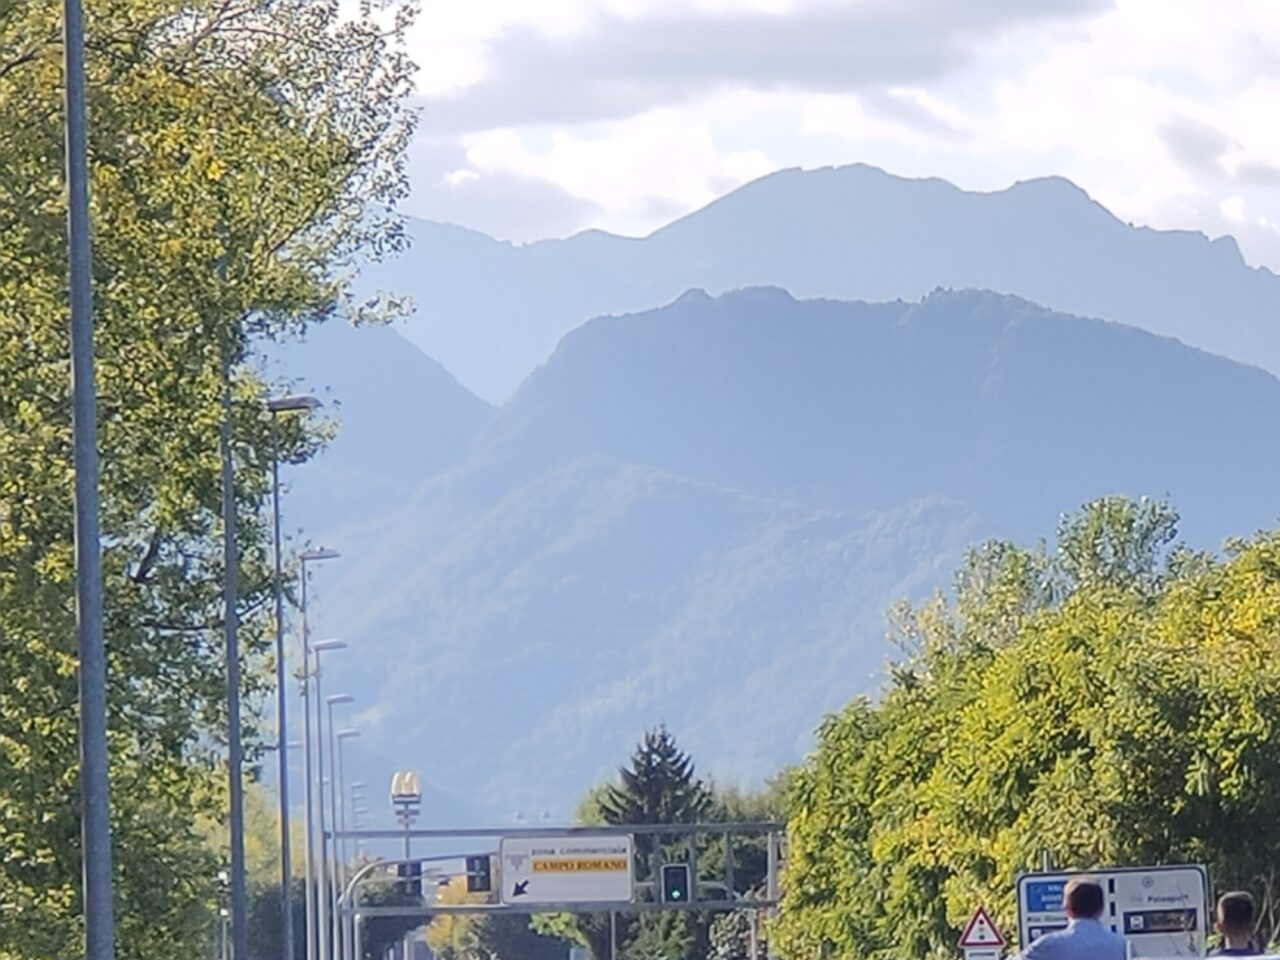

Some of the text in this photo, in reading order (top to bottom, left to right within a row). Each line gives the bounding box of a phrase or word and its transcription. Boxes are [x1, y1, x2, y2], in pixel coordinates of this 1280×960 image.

[559, 844, 627, 855] commerciale
[533, 859, 627, 872] CAMPO ROMANO
